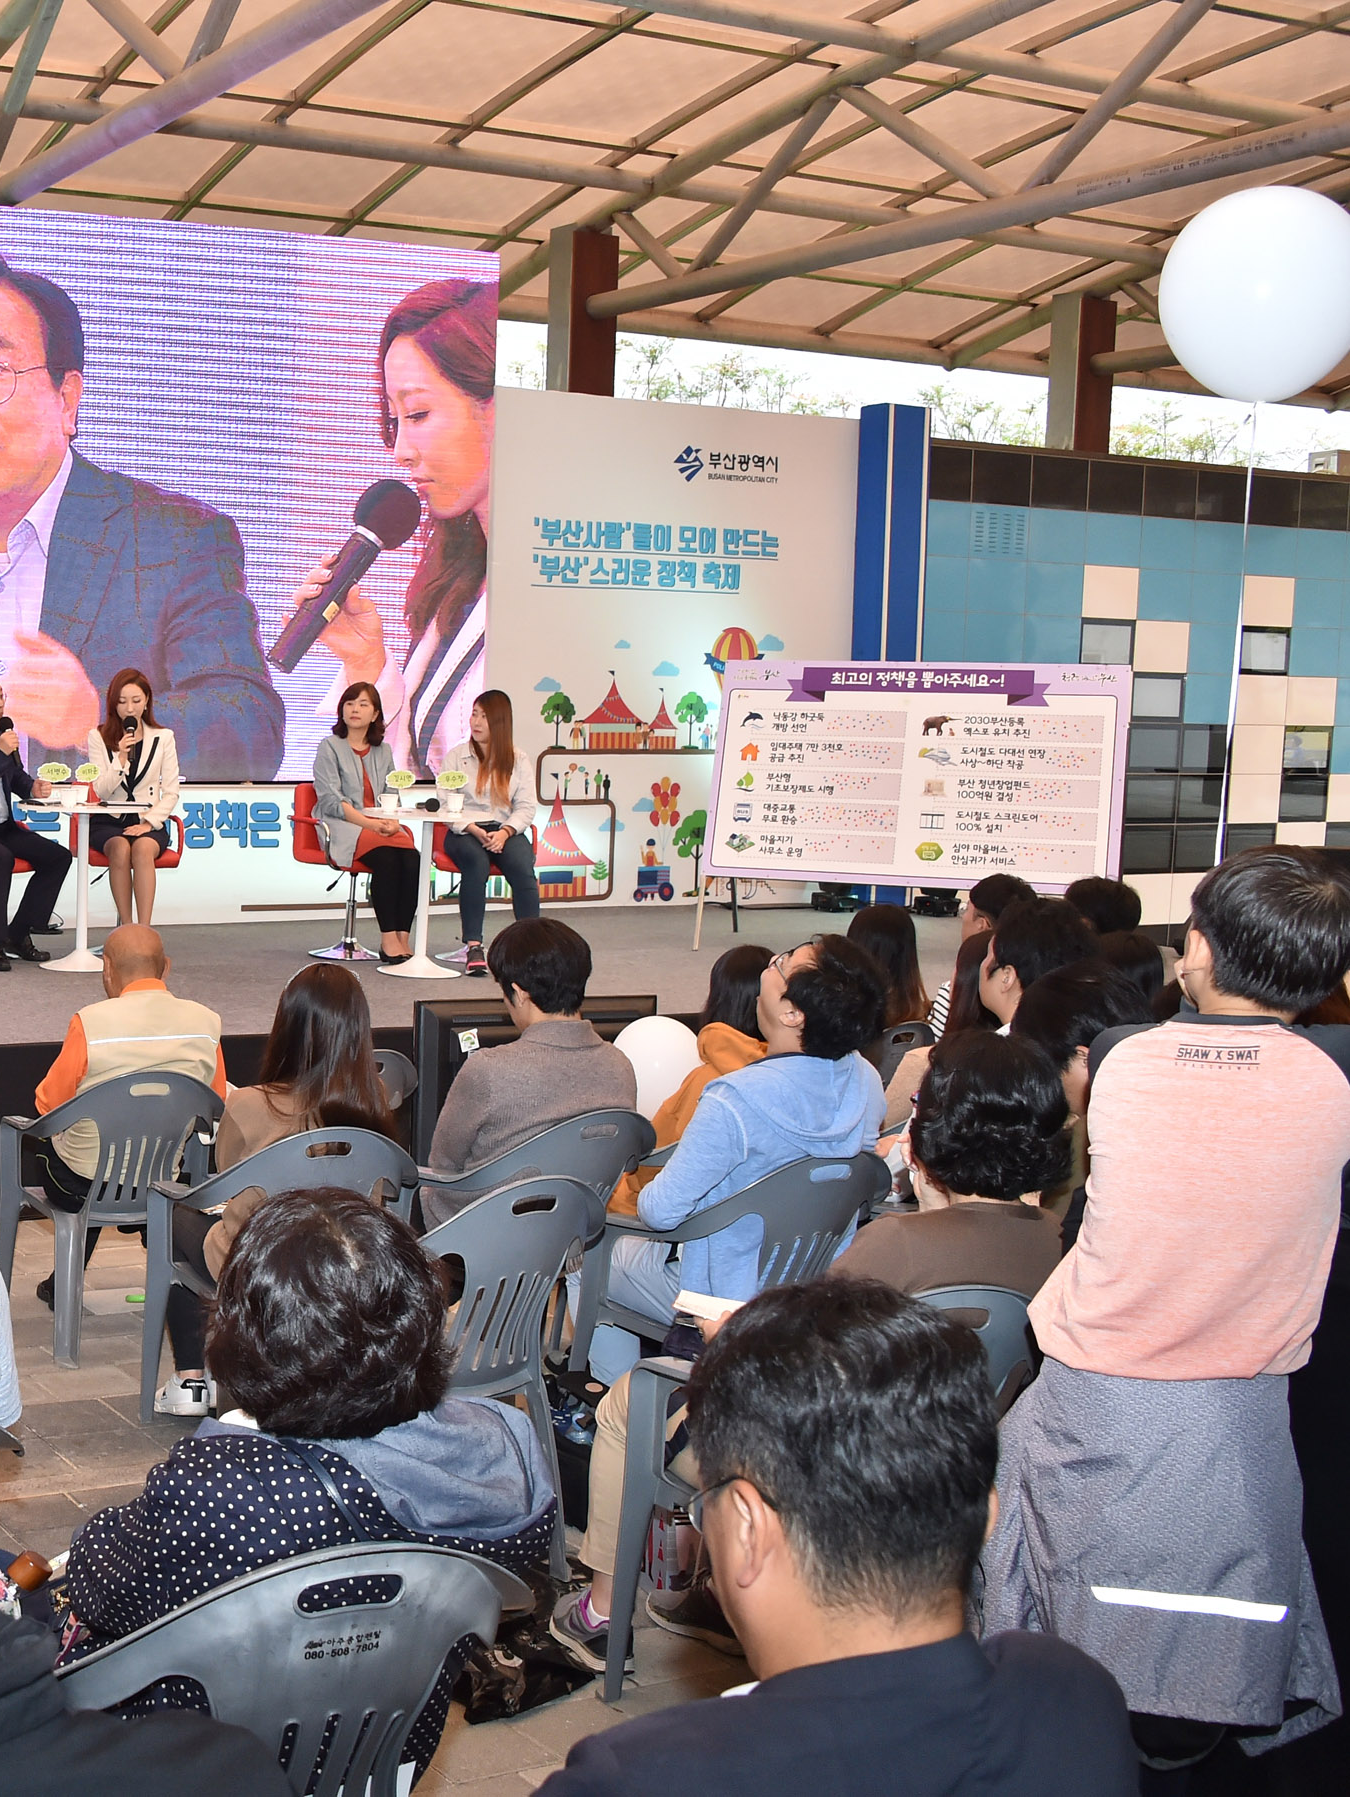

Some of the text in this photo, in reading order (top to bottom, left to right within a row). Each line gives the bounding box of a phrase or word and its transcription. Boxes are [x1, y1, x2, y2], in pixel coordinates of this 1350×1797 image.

[709, 452, 779, 473] 부산광역시
[726, 474, 765, 483] METROPOLITAN
[766, 476, 779, 484] CITY
[678, 525, 717, 554] 모여
[723, 528, 779, 557] 만드는
[532, 554, 741, 590] '부산'스러운 정책 축제
[830, 671, 1005, 688] 최고의 정책을 뽑아주세요~!
[773, 712, 824, 722] 낙동강 하굿둑
[964, 716, 1026, 727] 2030부산등록
[772, 722, 807, 733] 개방 선언
[963, 727, 1030, 739] 엑스포 유치 추진
[770, 742, 844, 753] 임대주택 7만 3천호
[960, 746, 1046, 760] 도시철도 다대선 연장
[768, 753, 804, 764] 공급 추진
[1006, 760, 1024, 770] 착공
[766, 784, 834, 796] 기초보장제도 시행
[958, 779, 1031, 791] 부산 청년창업펀드
[957, 790, 1014, 802] 100억원 결성
[763, 803, 796, 814] 대중교통
[762, 815, 798, 826] 무료 환승
[956, 810, 1038, 823] 도시철도 스크린도어
[182, 799, 281, 849] 정책은
[956, 822, 1003, 834] 100% 설치
[760, 834, 793, 844] 마을지기
[758, 846, 803, 858] 사무소 운영
[952, 843, 1008, 855] 심야 마을버스
[951, 855, 1016, 866] 안심귀가 서비스
[1176, 1047, 1260, 1060] SHAW X SWAT
[304, 1641, 380, 1660] 080-508-7804
